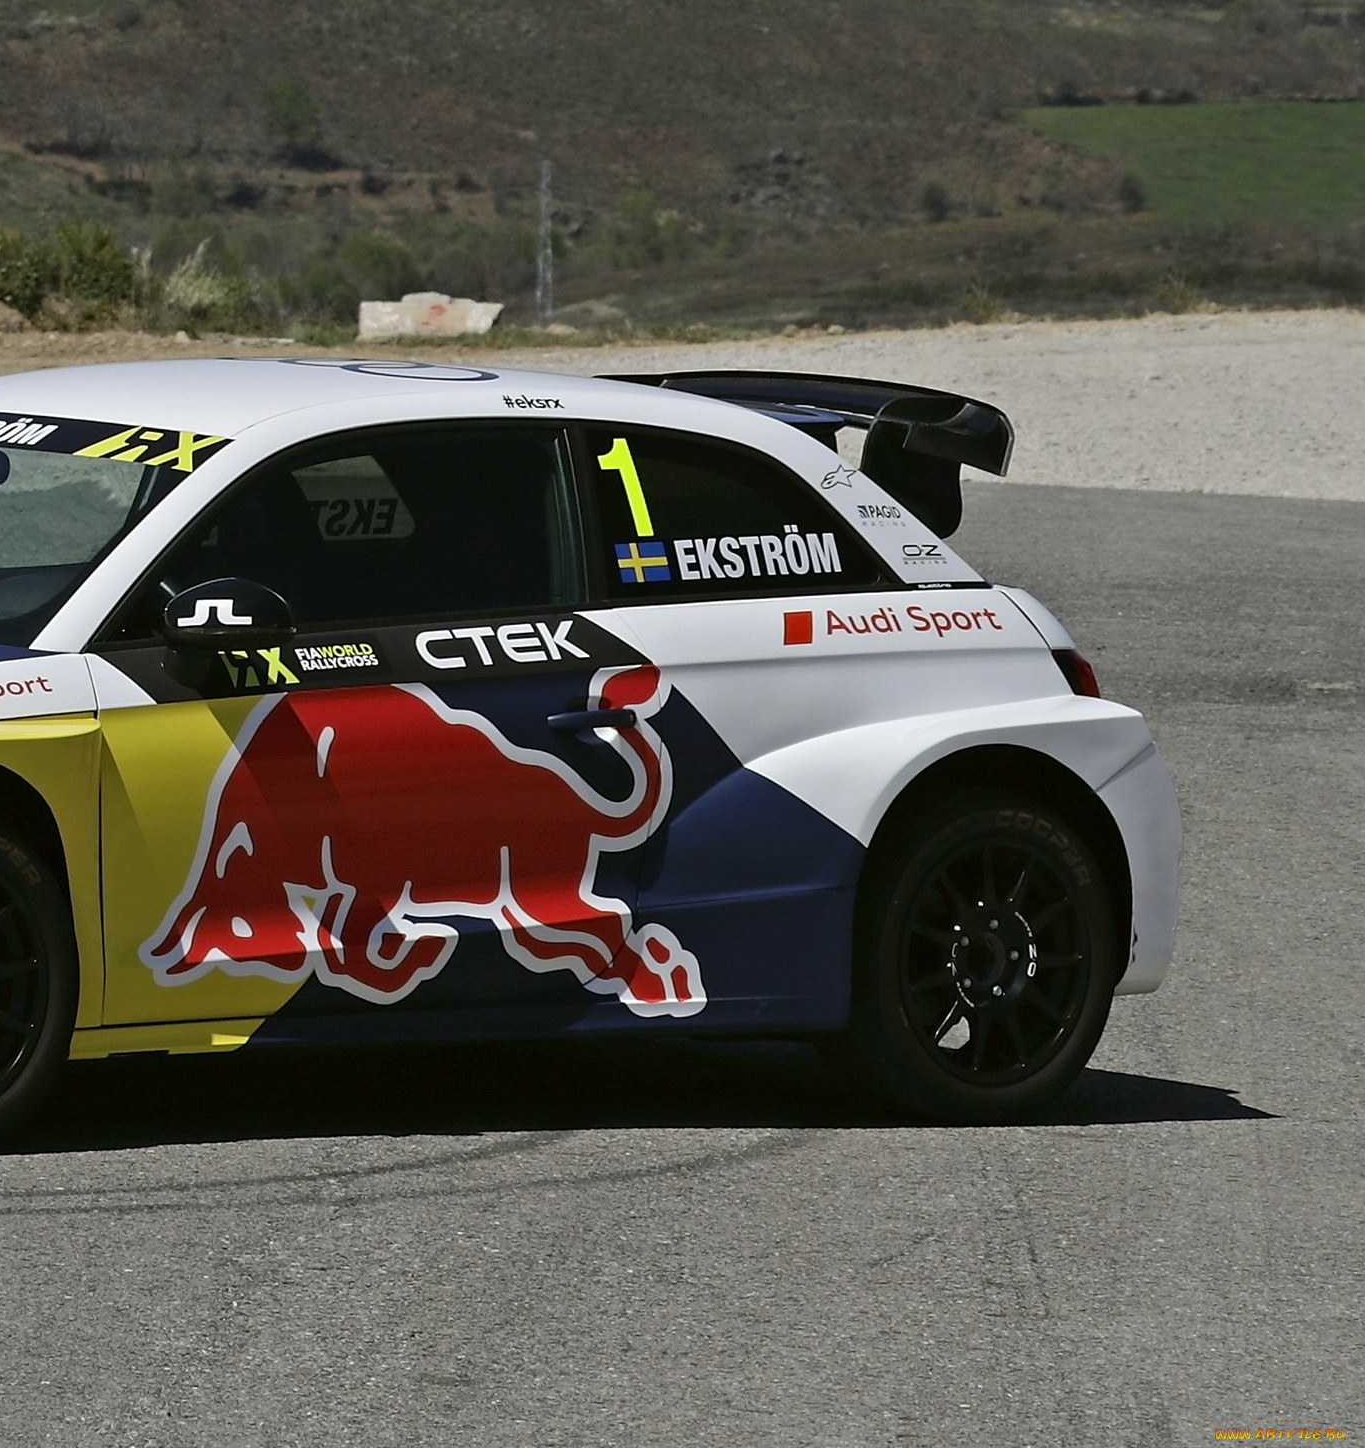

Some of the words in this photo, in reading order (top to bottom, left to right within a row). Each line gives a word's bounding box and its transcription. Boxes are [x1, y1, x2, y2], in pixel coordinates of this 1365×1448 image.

[502, 393, 565, 409] #eksrx
[597, 438, 654, 537] 1
[868, 505, 902, 519] PAGID
[673, 524, 842, 581] EKSTRÖM
[826, 607, 903, 636] Audi
[906, 605, 1003, 638] Sport
[415, 620, 591, 670] CTEK
[300, 654, 379, 672] RALLYCROSS
